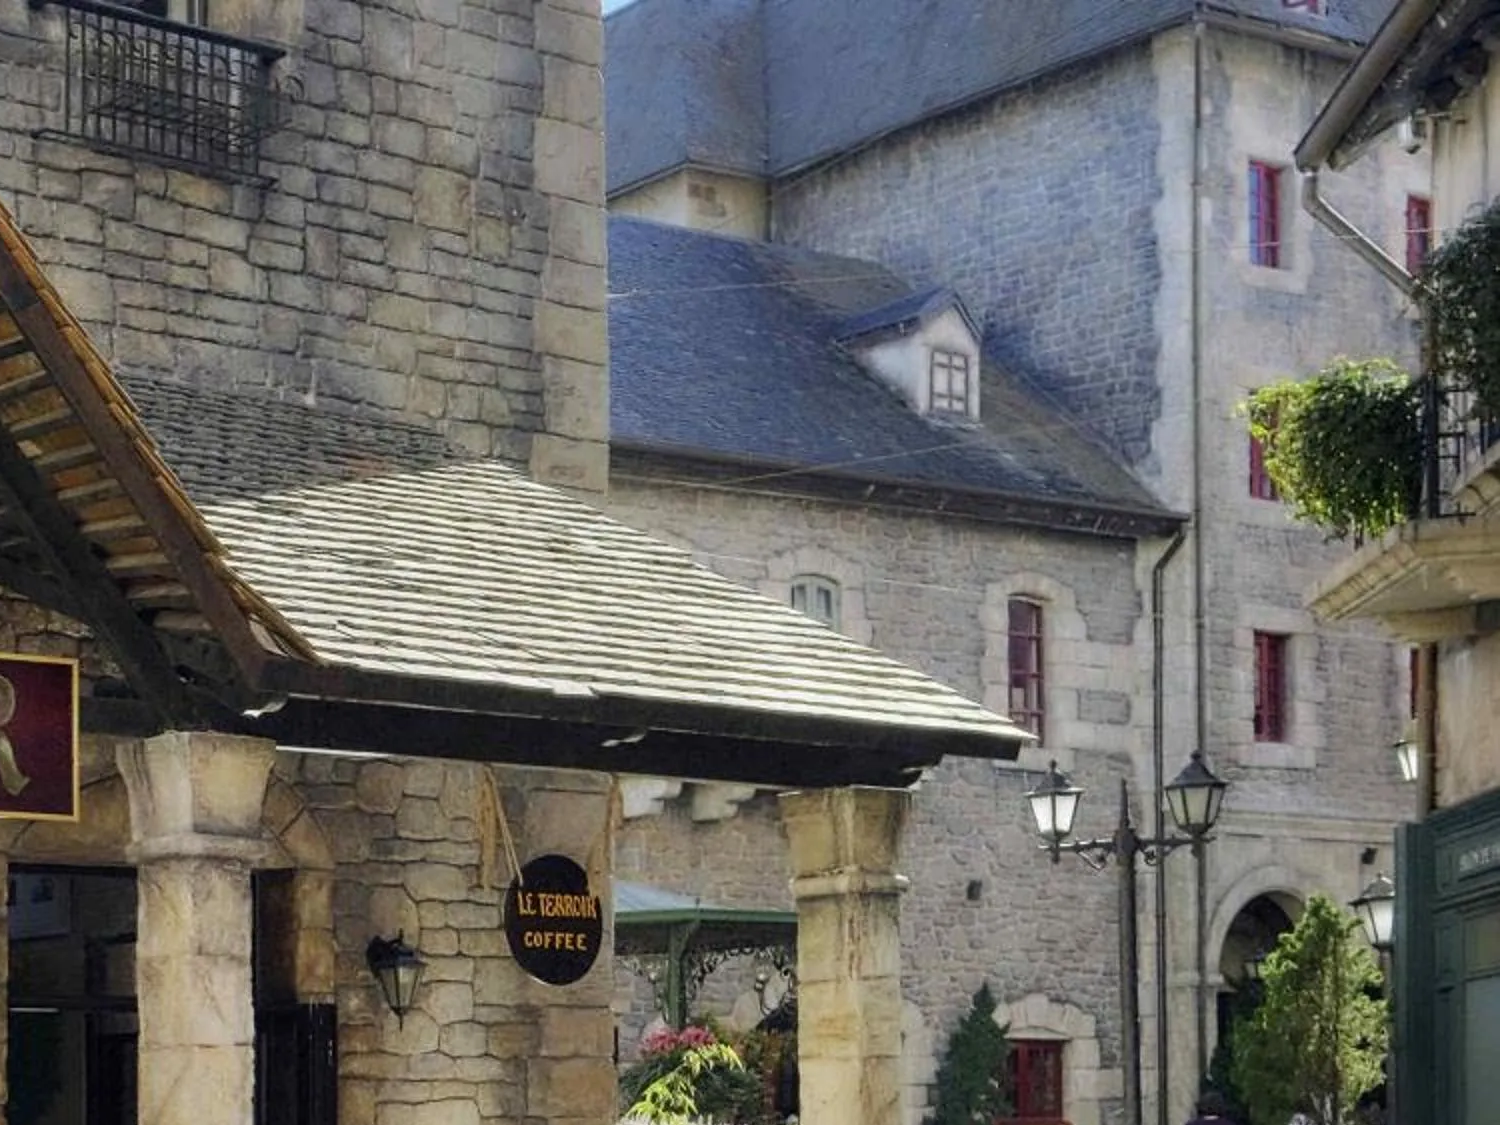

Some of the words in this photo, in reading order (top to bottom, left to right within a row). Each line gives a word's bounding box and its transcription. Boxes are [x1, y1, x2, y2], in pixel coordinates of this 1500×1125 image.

[518, 892, 536, 915] LE
[538, 894, 597, 918] TERROIR
[524, 931, 587, 950] COFFEE
